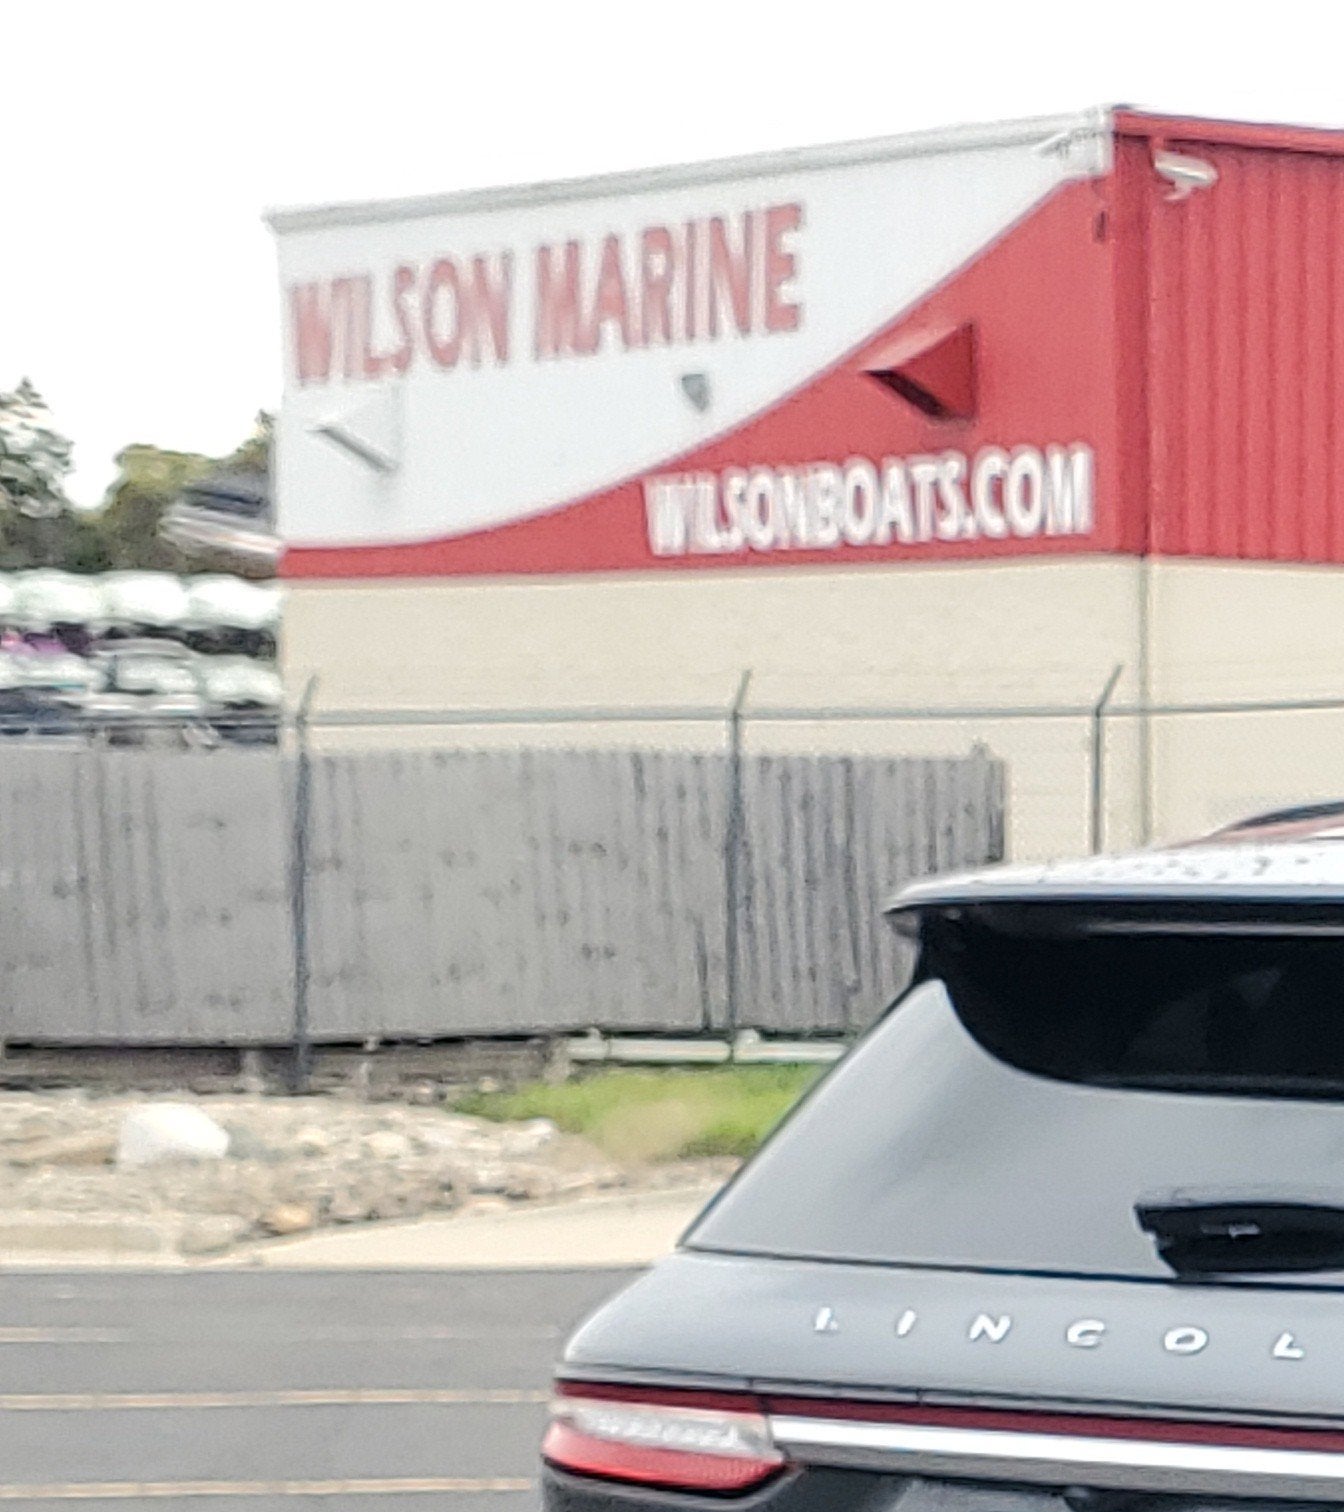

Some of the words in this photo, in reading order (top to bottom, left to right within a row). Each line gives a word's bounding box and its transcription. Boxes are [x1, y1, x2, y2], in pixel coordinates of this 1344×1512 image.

[292, 252, 514, 386] WILSON
[537, 203, 804, 361] MARINE
[643, 442, 1094, 556] WILSONBOATS.COM
